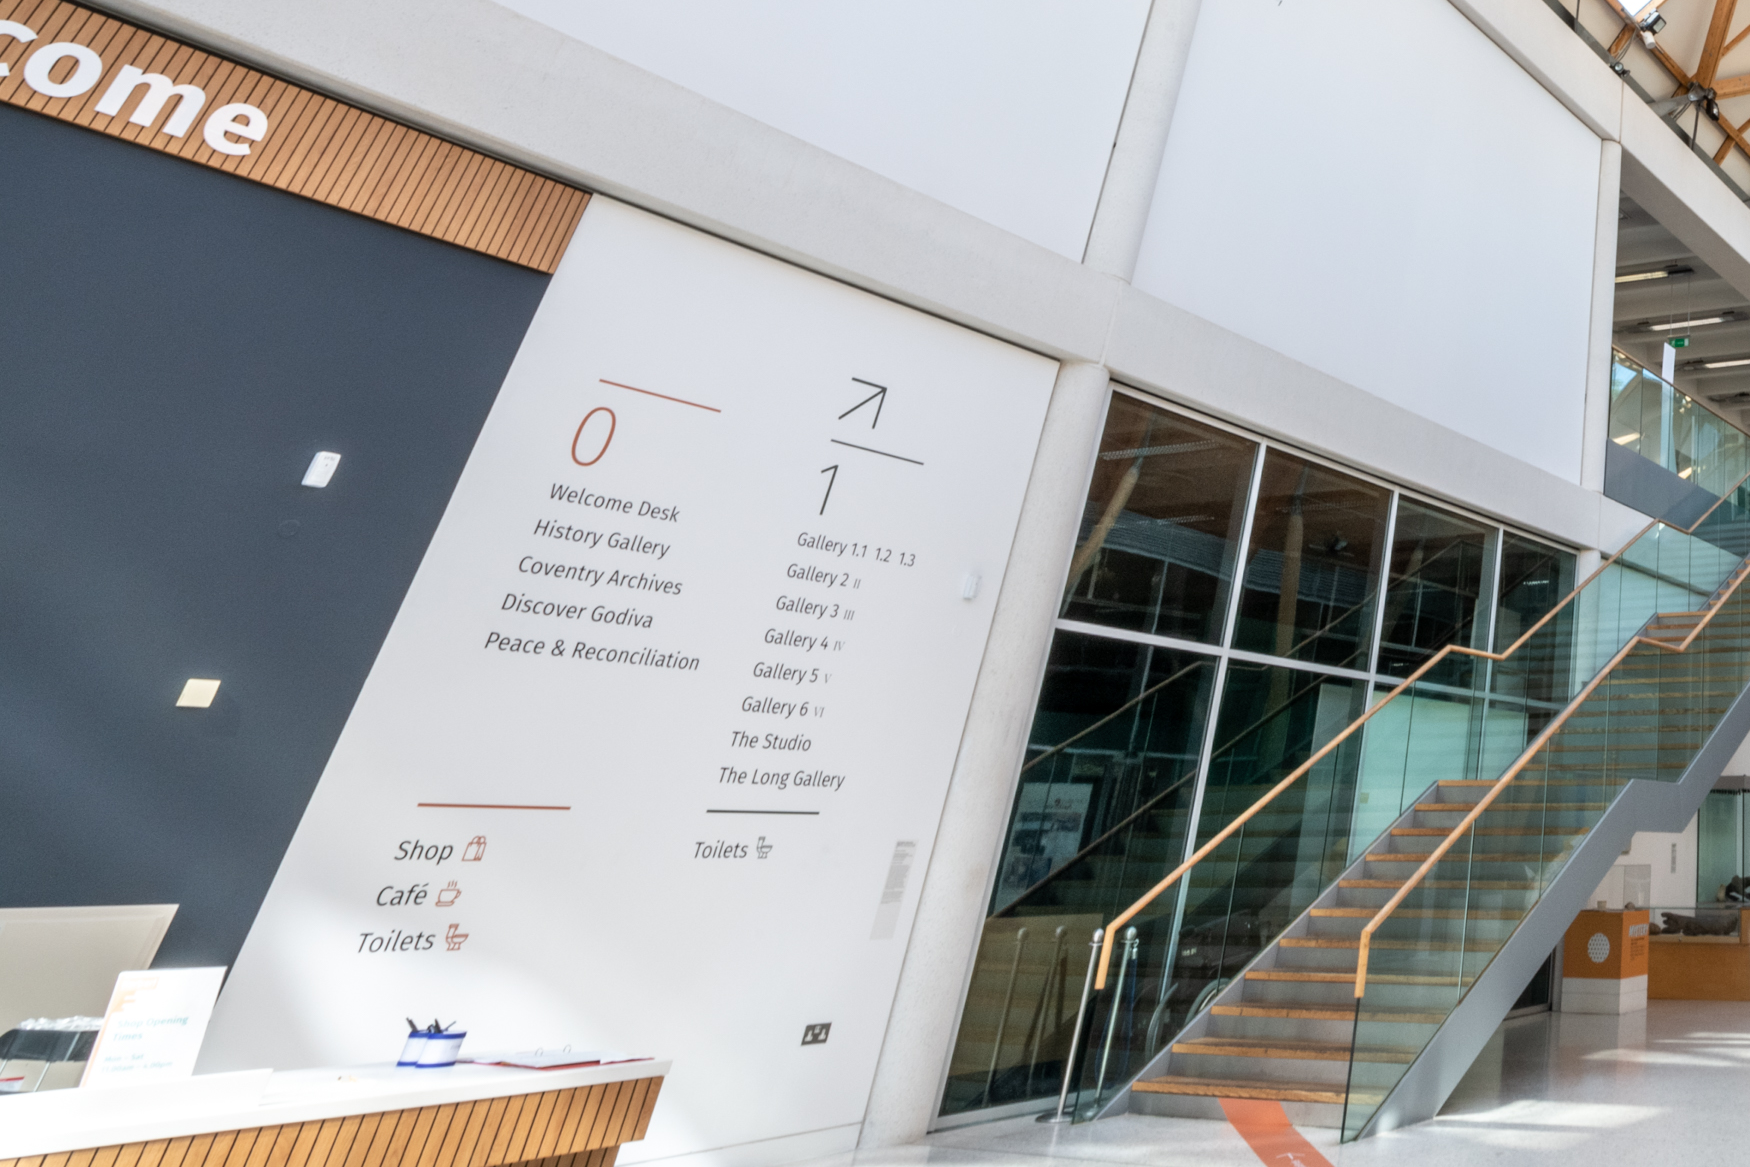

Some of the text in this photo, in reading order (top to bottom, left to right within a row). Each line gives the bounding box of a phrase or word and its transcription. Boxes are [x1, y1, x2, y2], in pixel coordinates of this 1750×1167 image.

[570, 405, 617, 468] 0
[549, 482, 681, 524] Welcome Desk
[818, 463, 840, 517] 1
[532, 518, 672, 561] History Gallery
[796, 531, 917, 568] Gallery 1.1 1.2 1.3
[518, 554, 684, 596] Coventry Archives
[786, 562, 839, 589] Gallery
[839, 572, 850, 588] 2
[500, 592, 654, 629] Discover Godiva
[775, 594, 829, 621] Gallery
[829, 603, 841, 619] 3
[483, 630, 701, 672] Peace & Reconciliation
[763, 627, 819, 653] Gallery
[819, 635, 829, 651] 4
[752, 660, 808, 686] Gallery
[808, 667, 821, 684] 5
[741, 695, 798, 720] Gallery
[798, 700, 810, 718] 6
[730, 729, 812, 753] The Studio
[718, 765, 847, 793] The Long Gallery
[393, 838, 455, 867] Shop
[693, 839, 750, 860] Toilets
[375, 881, 430, 908] Café
[357, 928, 437, 954] Toilets
[117, 1015, 190, 1029] Shop Opening
[112, 1031, 143, 1042] Times
[131, 1053, 145, 1061] Sat
